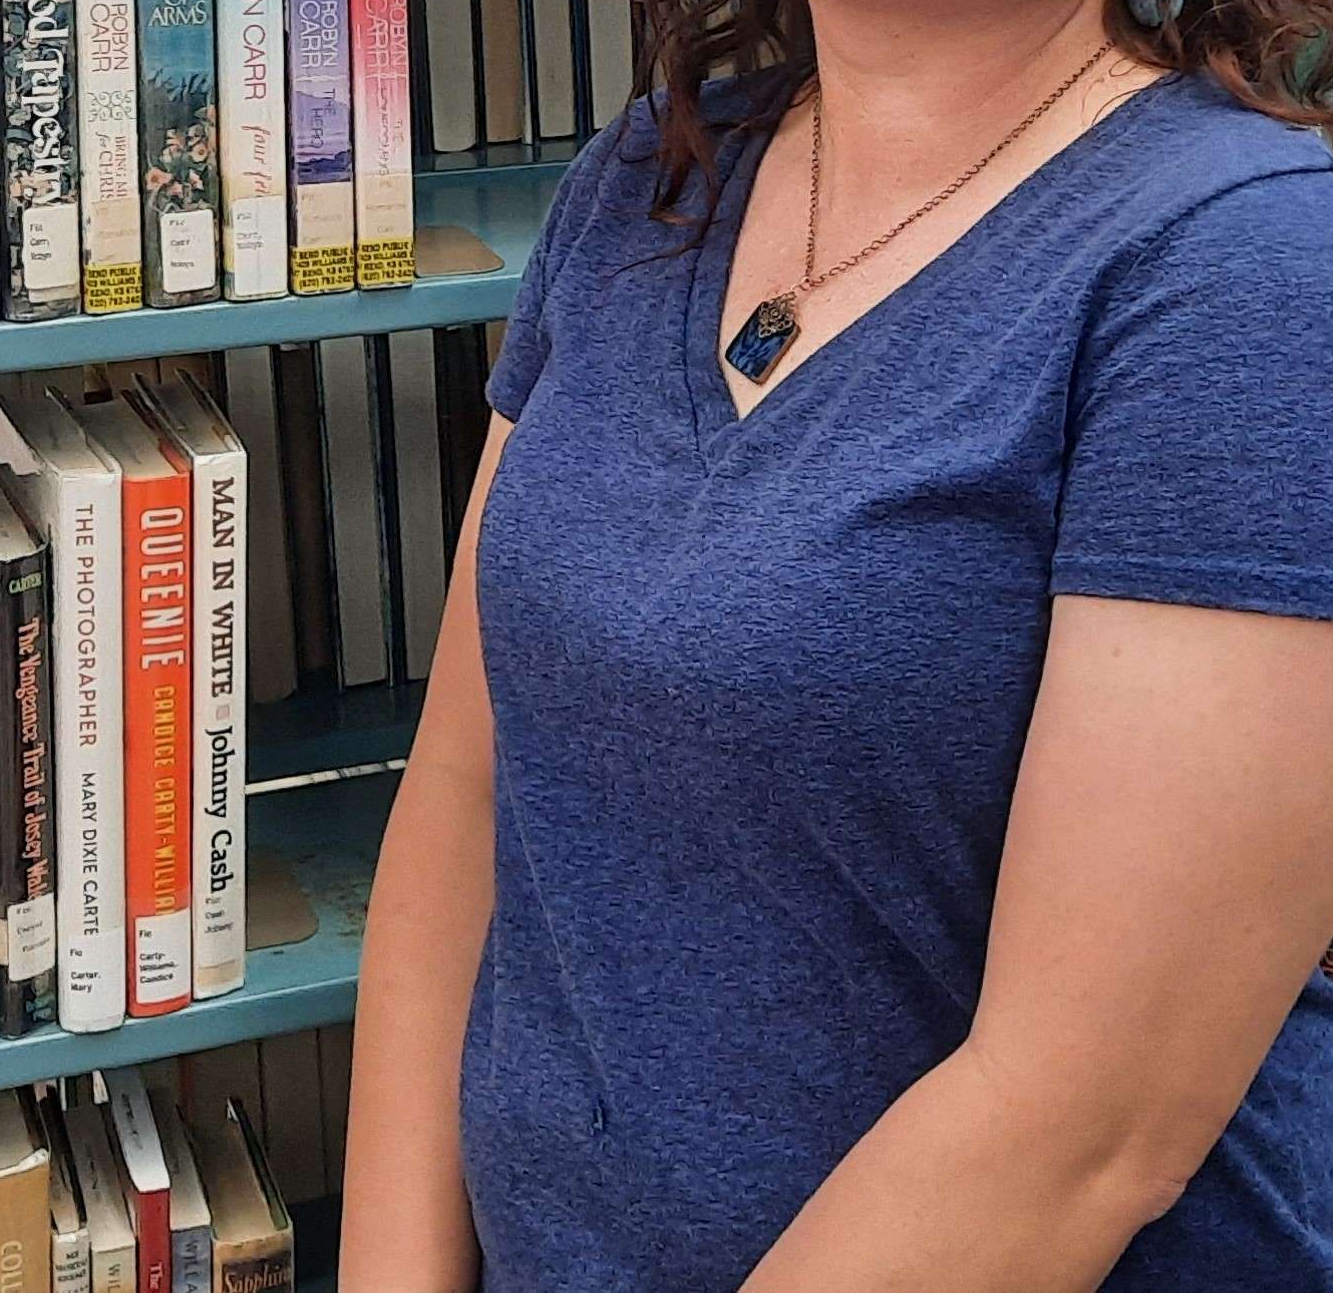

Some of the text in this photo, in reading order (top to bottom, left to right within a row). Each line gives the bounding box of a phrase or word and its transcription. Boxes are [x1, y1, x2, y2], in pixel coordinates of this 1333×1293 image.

[88, 2, 112, 74] CARR
[111, 1, 131, 74] ROBYN
[147, 2, 209, 28] ARMS
[297, 0, 323, 69] CARR
[319, 0, 341, 68] ROBYN
[241, 22, 269, 101] CARR
[71, 502, 100, 749] THE PHOTOGRAPHER
[137, 506, 187, 672] QUEENIE
[210, 477, 238, 699] MAN IN WHITE
[152, 684, 177, 769] CANDICE
[80, 771, 100, 875] MARY DIXIE
[203, 724, 238, 896] Johnny Cash
